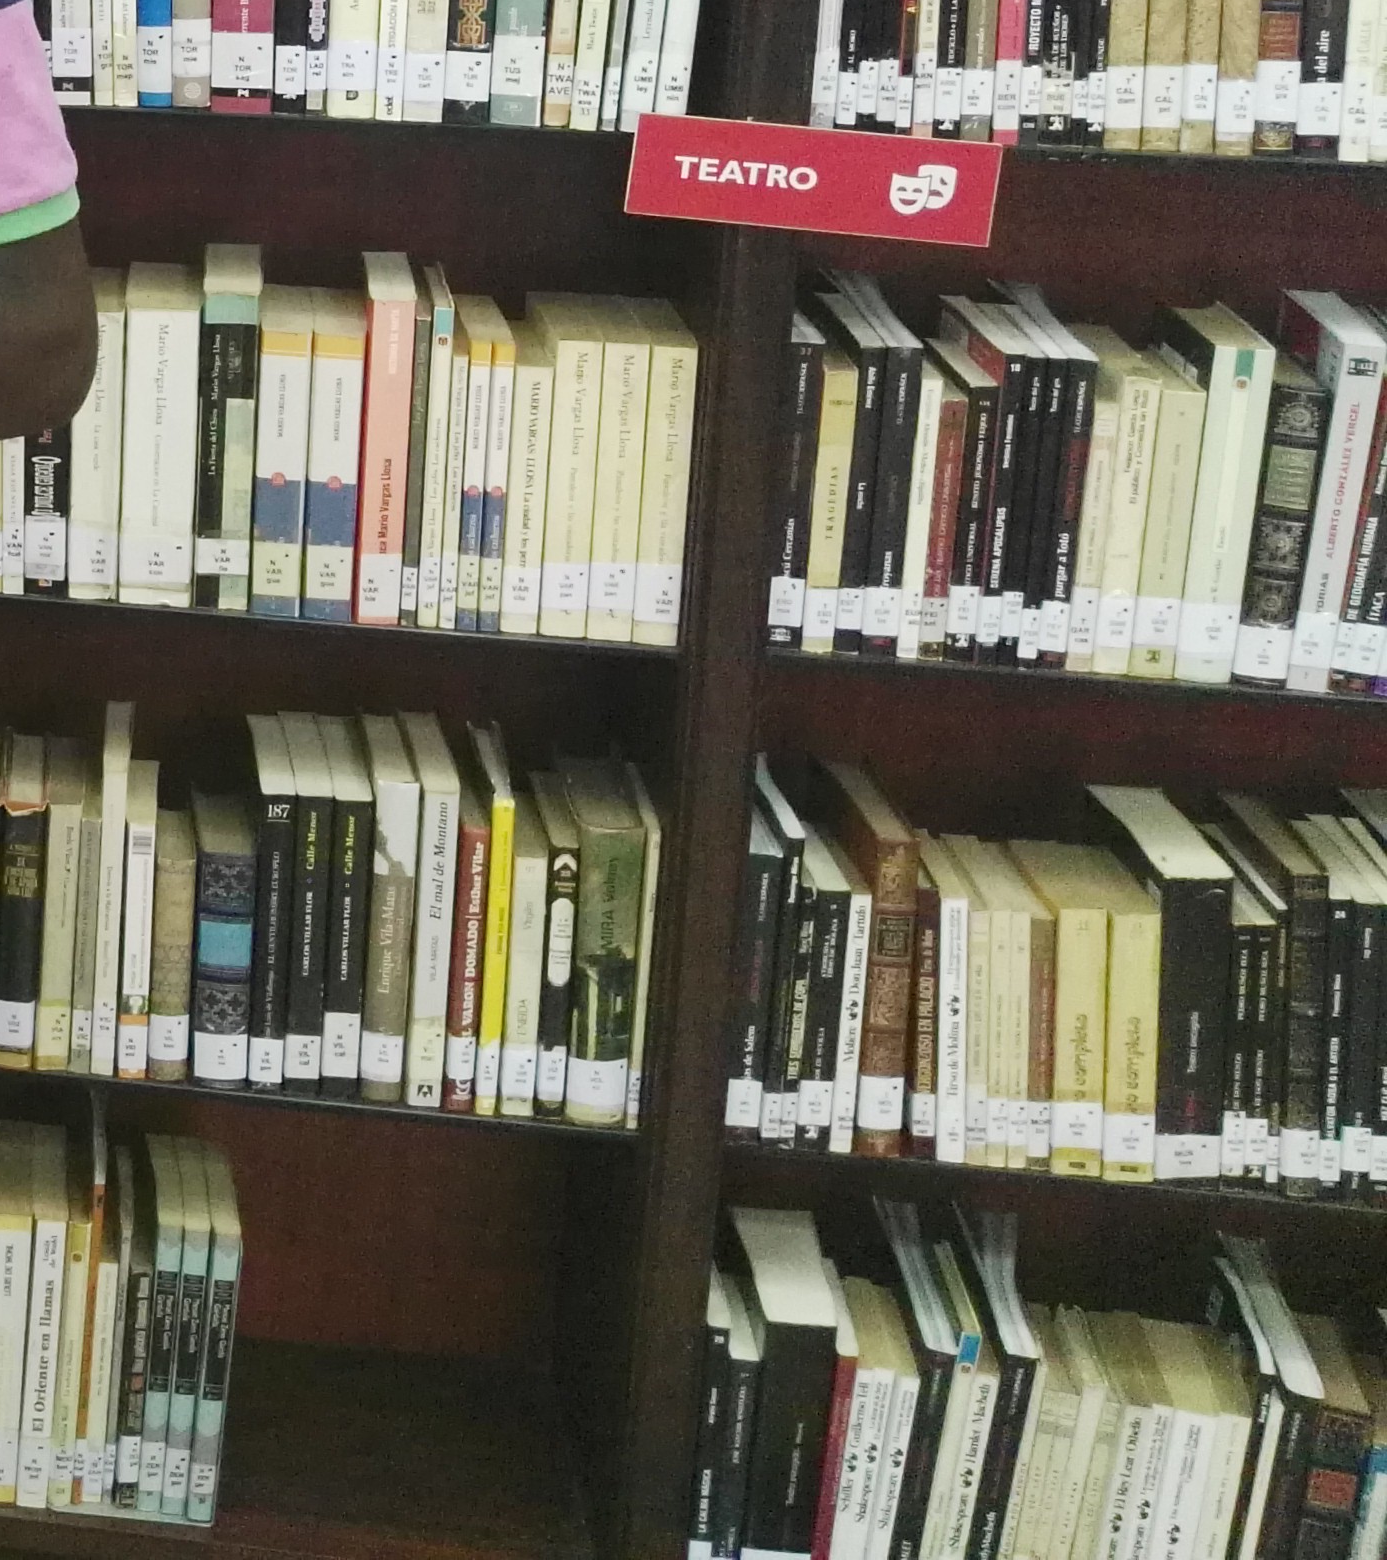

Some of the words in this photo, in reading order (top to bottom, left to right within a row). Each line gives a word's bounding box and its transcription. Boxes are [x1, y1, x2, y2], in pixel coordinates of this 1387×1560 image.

[1315, 30, 1330, 53] aire
[548, 73, 573, 84] TWA
[1314, 55, 1329, 74] del
[548, 85, 571, 96] AVE
[674, 155, 819, 191] TEATRO
[156, 324, 169, 356] Mario
[154, 359, 168, 395] Vargas
[154, 397, 167, 425] Llosa
[267, 804, 291, 820] 187
[306, 811, 318, 841] Menor
[432, 801, 449, 858] Montano
[305, 843, 318, 870] Calle
[431, 861, 446, 878] de
[471, 841, 485, 873] Vilar
[431, 880, 444, 902] mal
[468, 874, 484, 914] Esther
[379, 886, 396, 946] Vila-Matas
[429, 905, 442, 920] El
[303, 919, 314, 946] VILLAR
[301, 948, 311, 976] CARLOS
[462, 919, 481, 978] DOMADO
[377, 949, 393, 994] Enrique
[39, 1279, 55, 1328] llamas
[38, 1332, 50, 1351] en
[34, 1356, 50, 1414] Oriente
[971, 1383, 992, 1425] Macbeth
[32, 1416, 45, 1433] El
[963, 1429, 982, 1464] Hamlet
